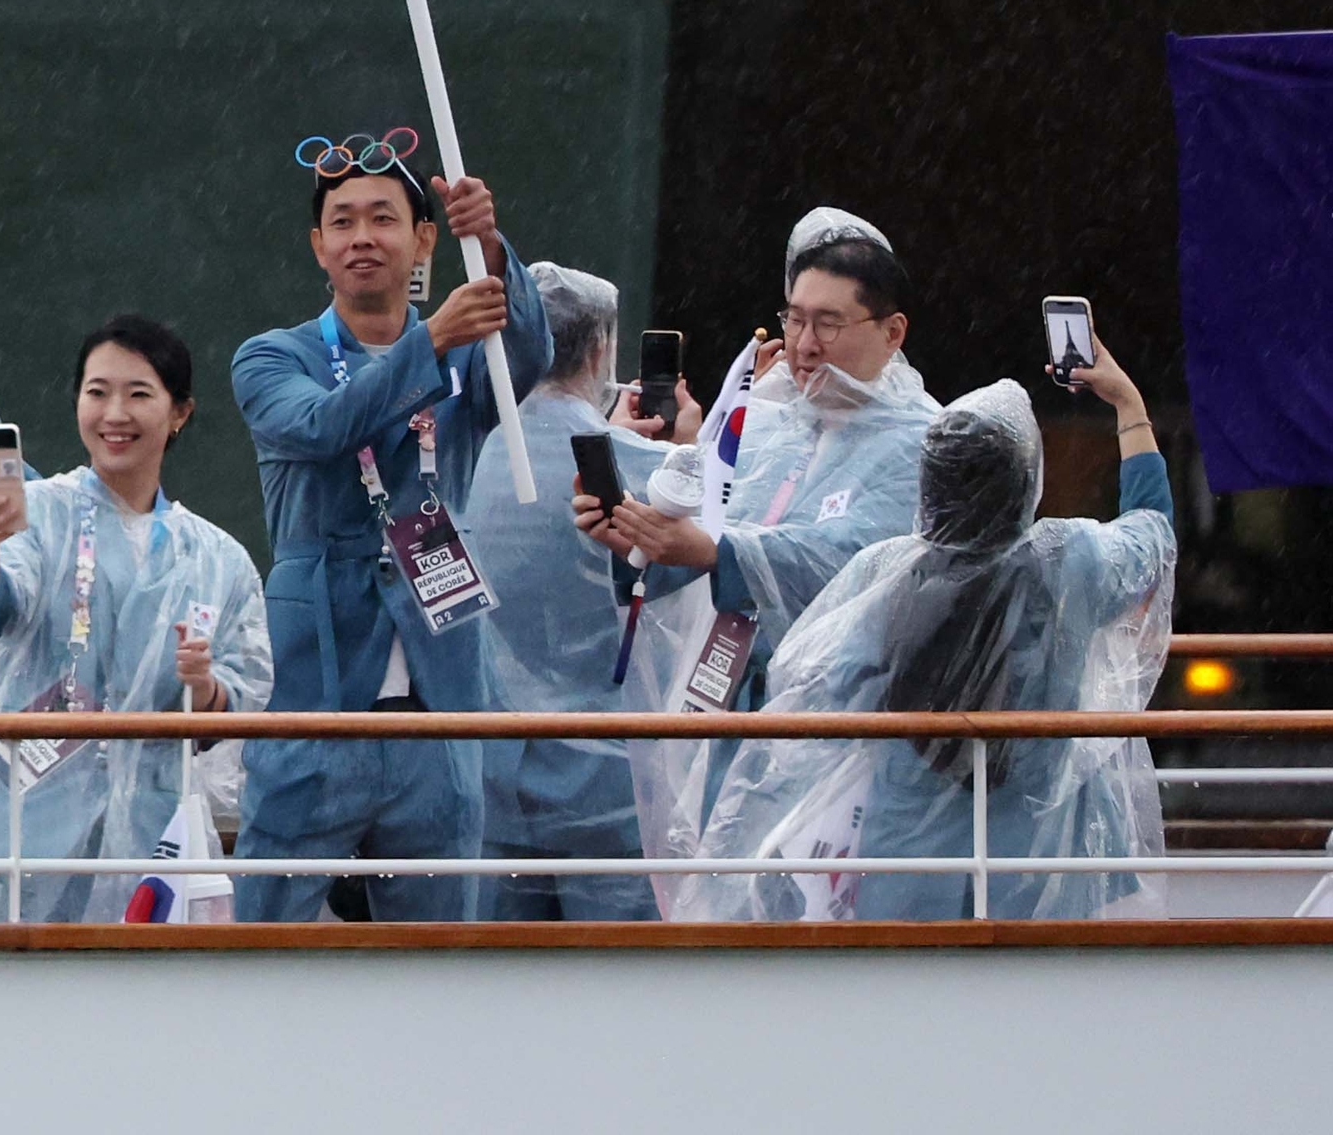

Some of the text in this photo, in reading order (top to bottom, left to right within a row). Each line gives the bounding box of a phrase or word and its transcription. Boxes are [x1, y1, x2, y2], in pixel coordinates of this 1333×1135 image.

[420, 550, 451, 570] KOR
[417, 563, 467, 588] RÉPUBLIQUE
[426, 575, 467, 597] DE CORÉE
[444, 612, 453, 622] 2
[709, 653, 730, 672] KOR
